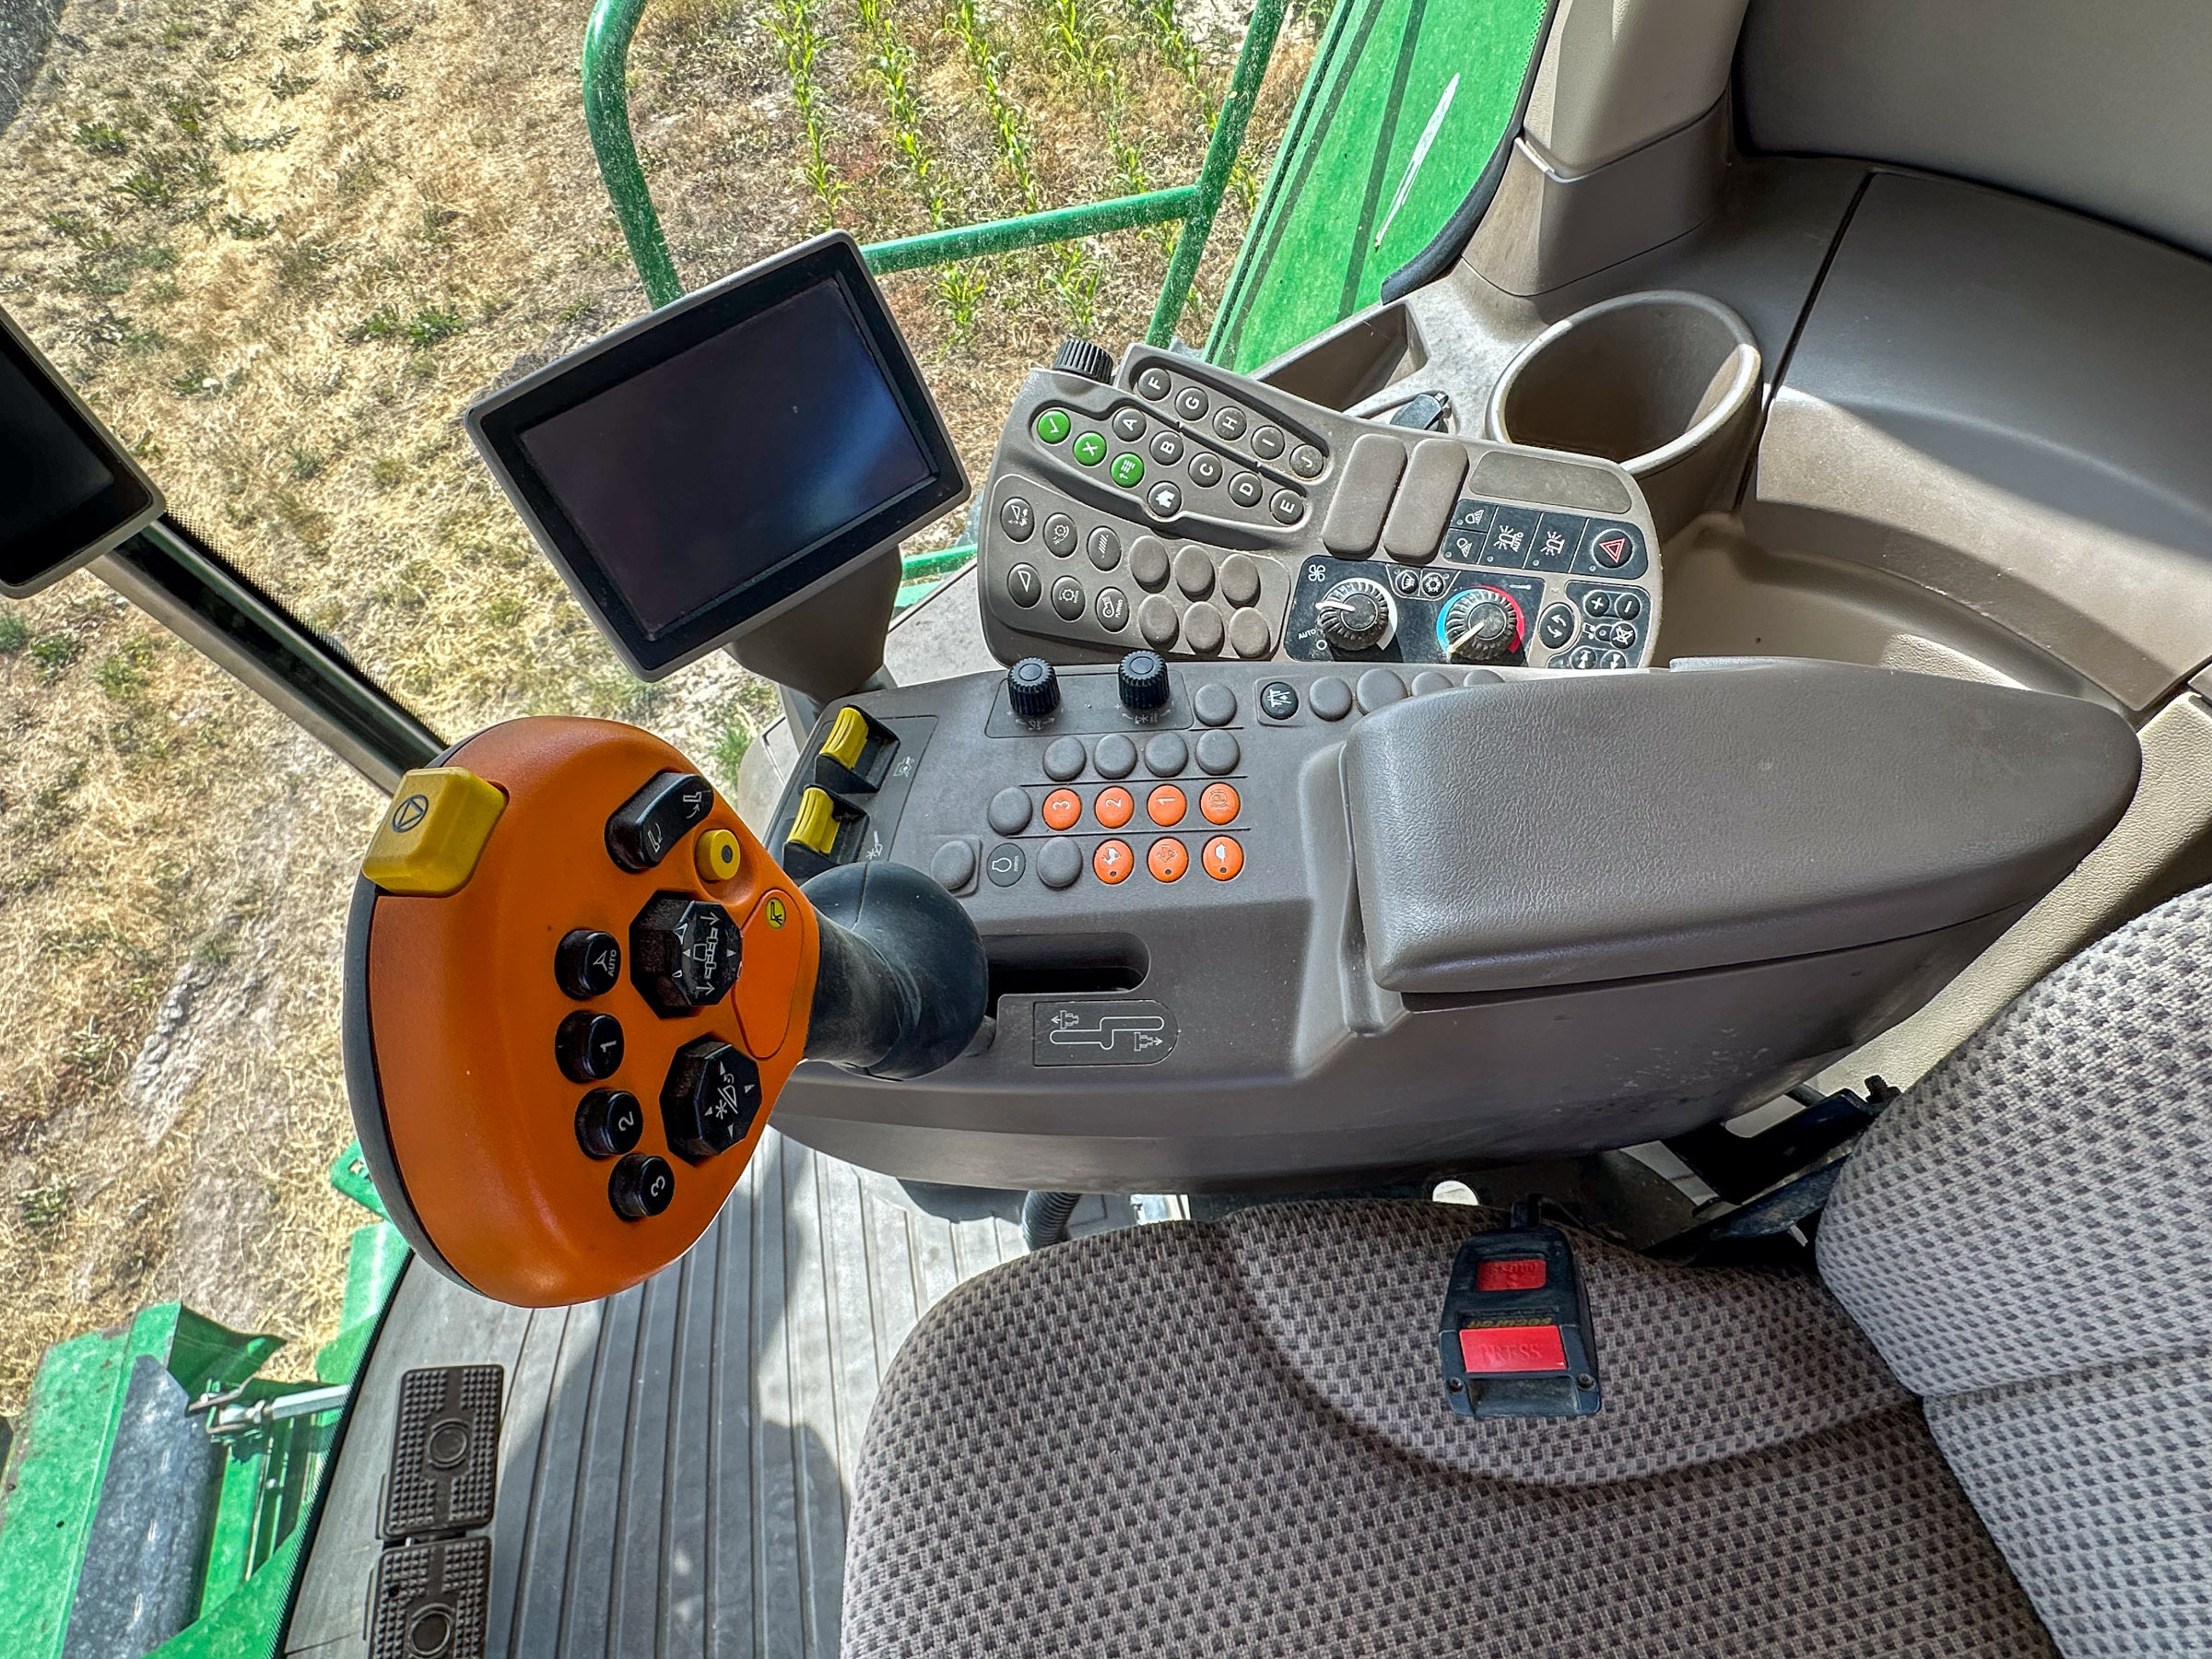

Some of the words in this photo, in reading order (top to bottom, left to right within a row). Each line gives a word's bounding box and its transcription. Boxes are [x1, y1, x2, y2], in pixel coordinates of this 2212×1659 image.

[1147, 376, 1161, 391] F
[1185, 396, 1200, 410] G
[1122, 418, 1138, 431] A
[1221, 416, 1238, 431] H
[1159, 441, 1175, 455] B
[1262, 438, 1276, 447] I
[1300, 455, 1313, 468] J
[1199, 463, 1214, 477] C
[1239, 482, 1253, 497] D
[1279, 499, 1296, 514] E
[1511, 531, 1524, 553] AUTO
[1298, 629, 1317, 640] AUTO
[1052, 800, 1071, 810] 3
[1105, 799, 1122, 807] 2
[1157, 797, 1175, 806] 1
[607, 949, 617, 977] AUTO
[599, 1039, 617, 1053] 1
[618, 1111, 635, 1132] 2
[650, 1175, 666, 1197] 3
[1479, 1343, 1543, 1363] PRESS
